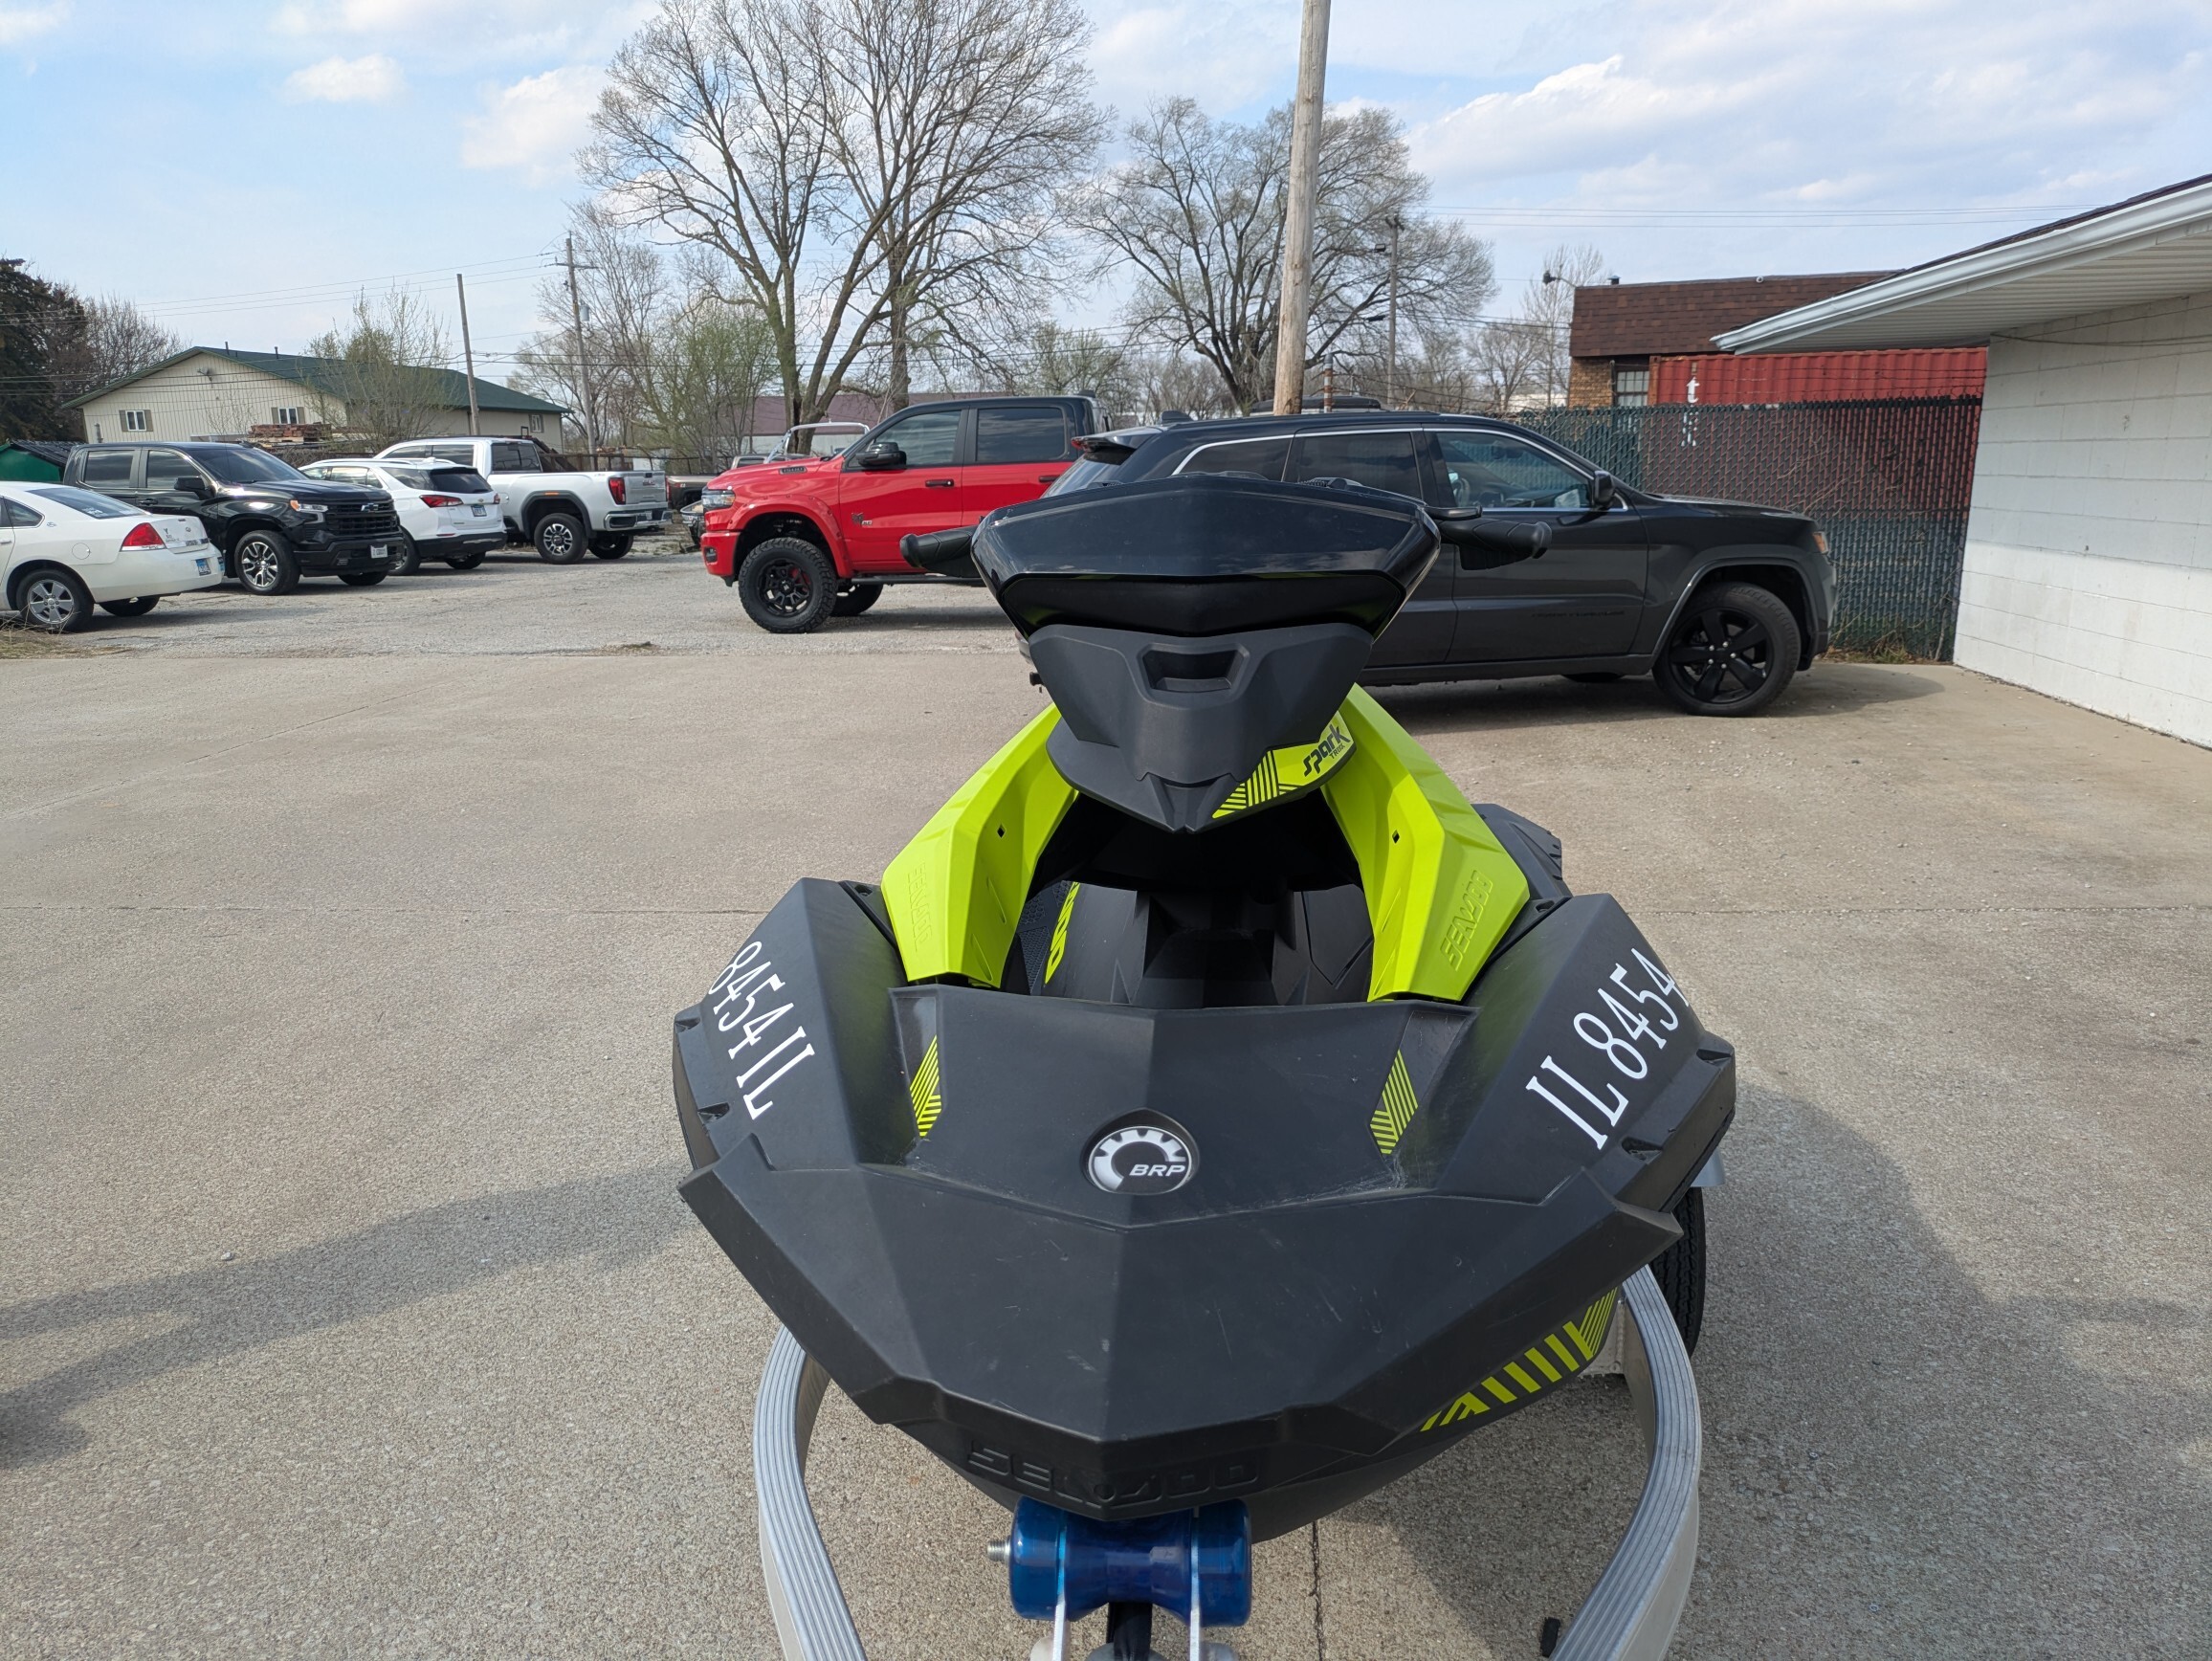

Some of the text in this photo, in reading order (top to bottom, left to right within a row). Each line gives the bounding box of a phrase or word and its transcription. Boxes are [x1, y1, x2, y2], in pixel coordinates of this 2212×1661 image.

[1525, 948, 1689, 1150] IL 8454
[1129, 1163, 1185, 1176] BRP
